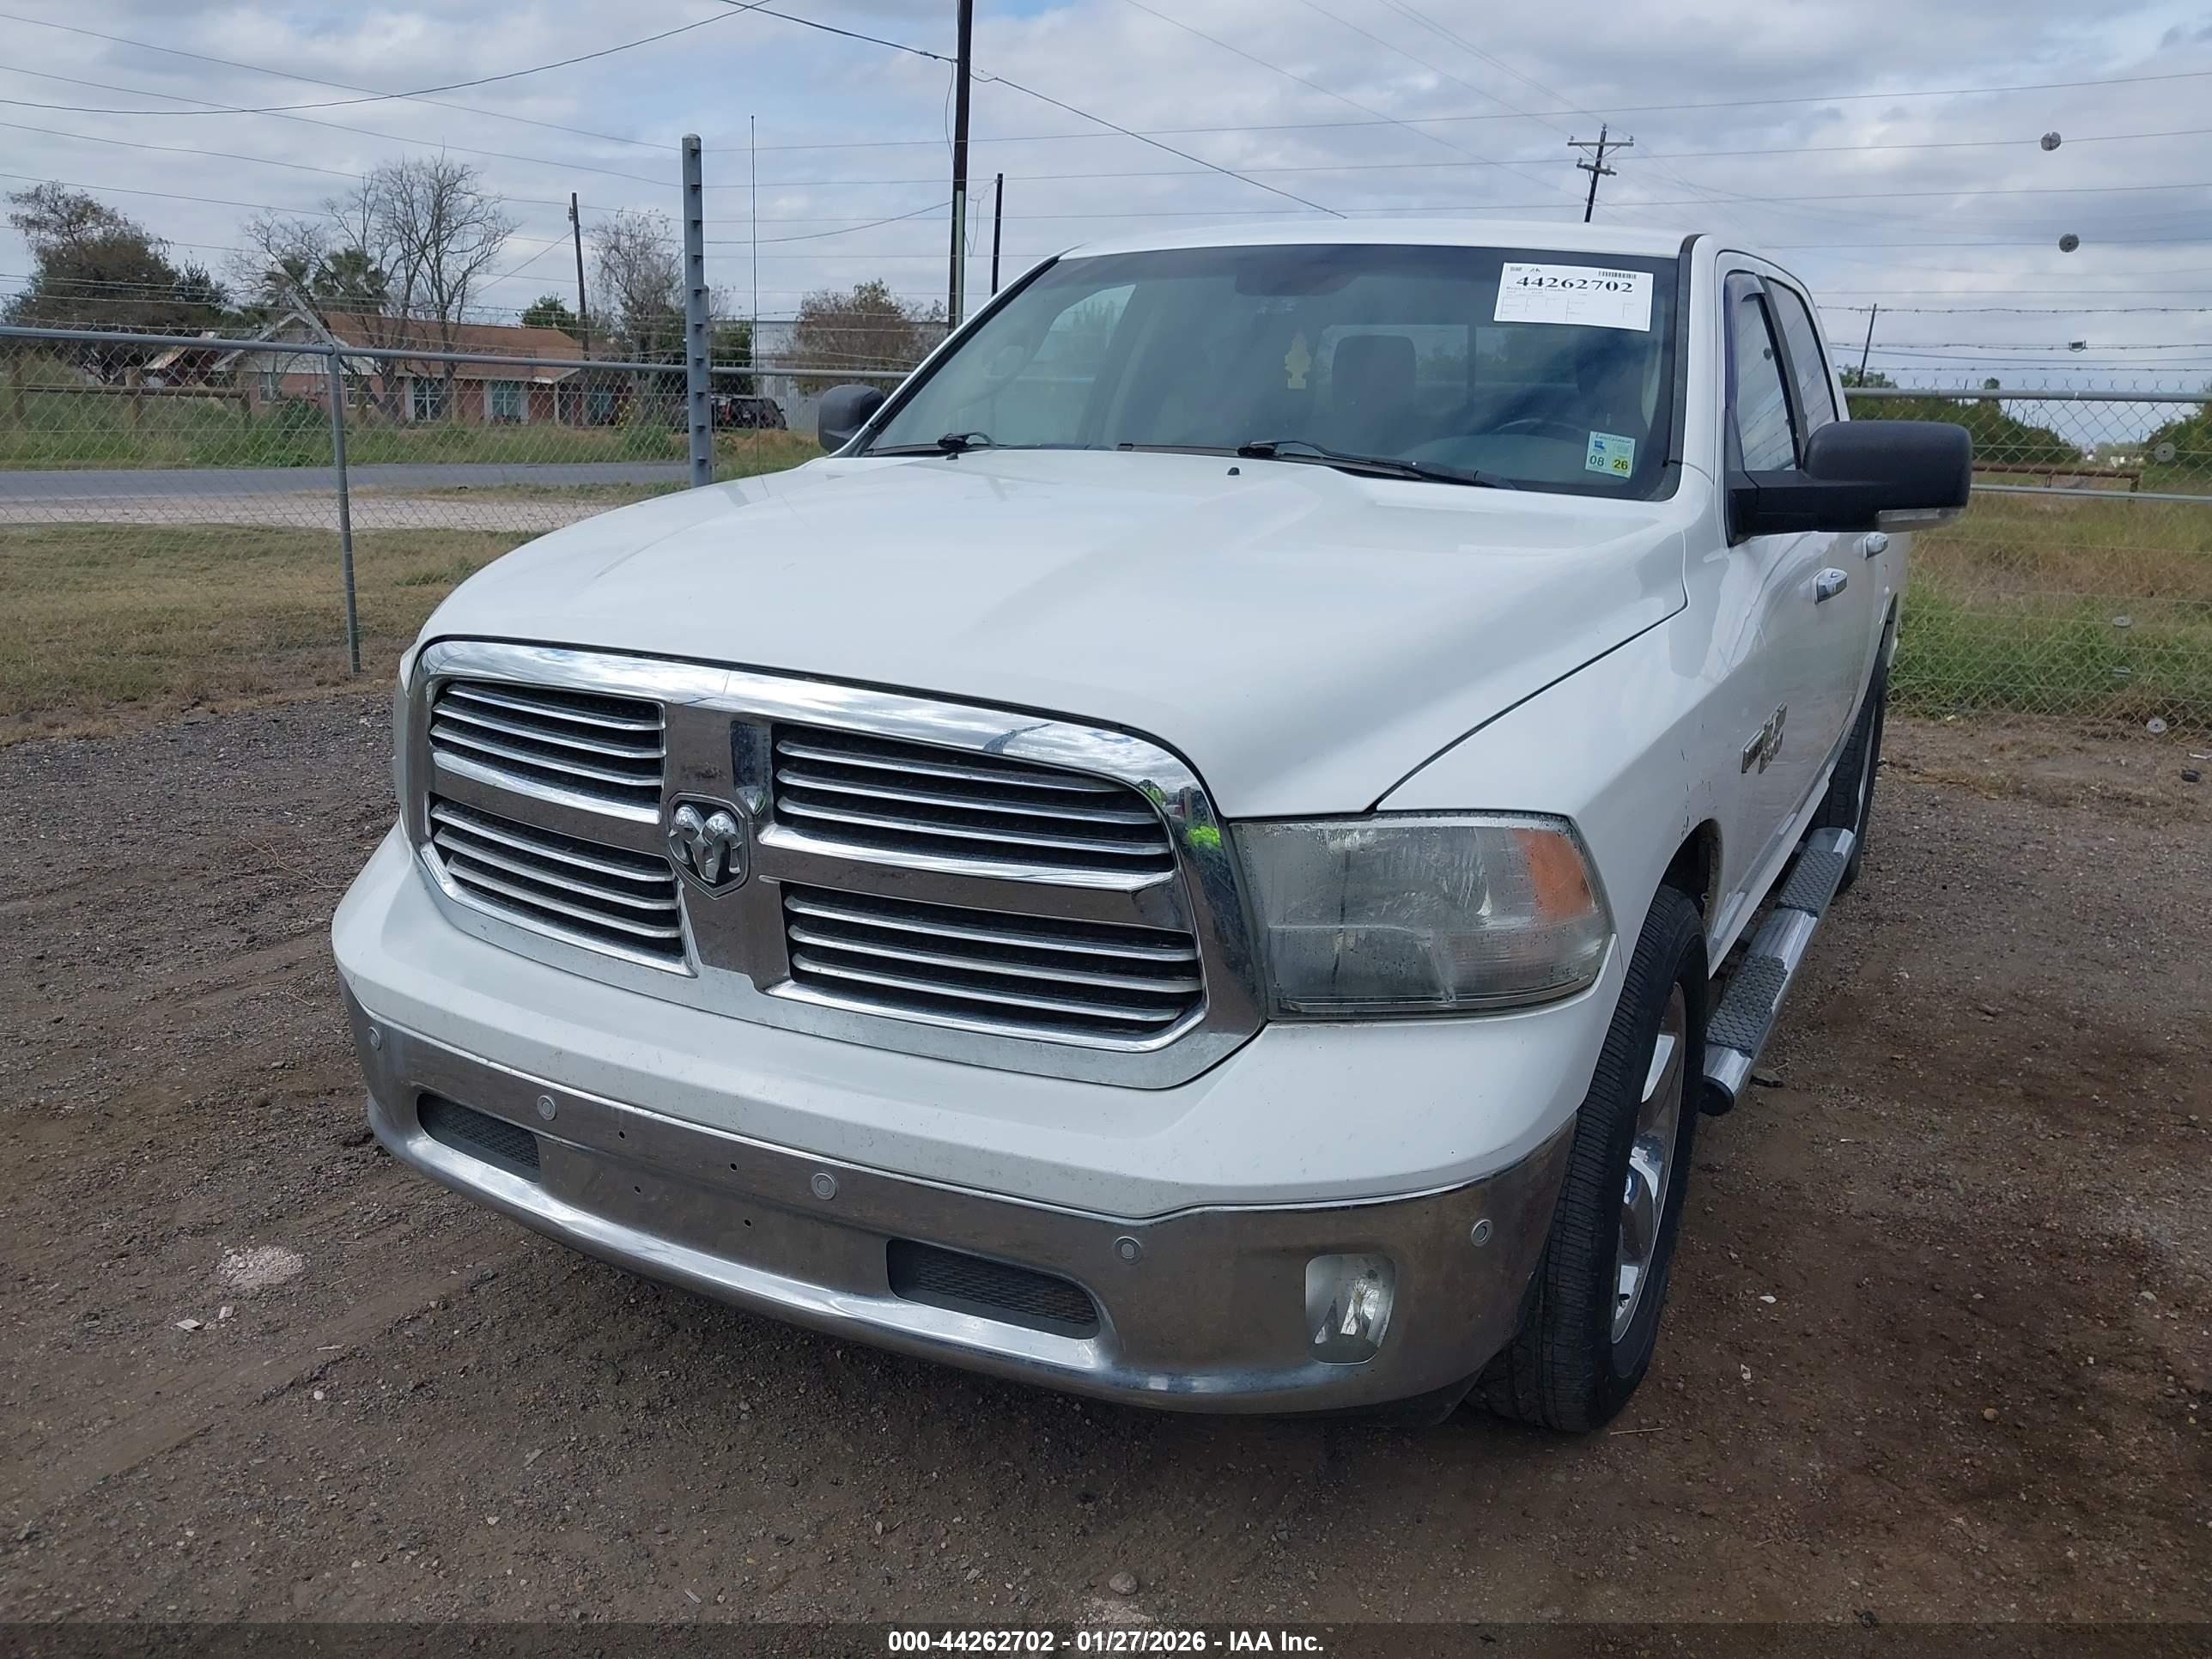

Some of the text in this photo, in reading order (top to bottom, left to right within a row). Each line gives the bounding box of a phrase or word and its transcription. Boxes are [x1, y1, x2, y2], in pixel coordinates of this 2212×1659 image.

[1516, 276, 1633, 293] 44262702
[1589, 454, 1628, 471] 08 26
